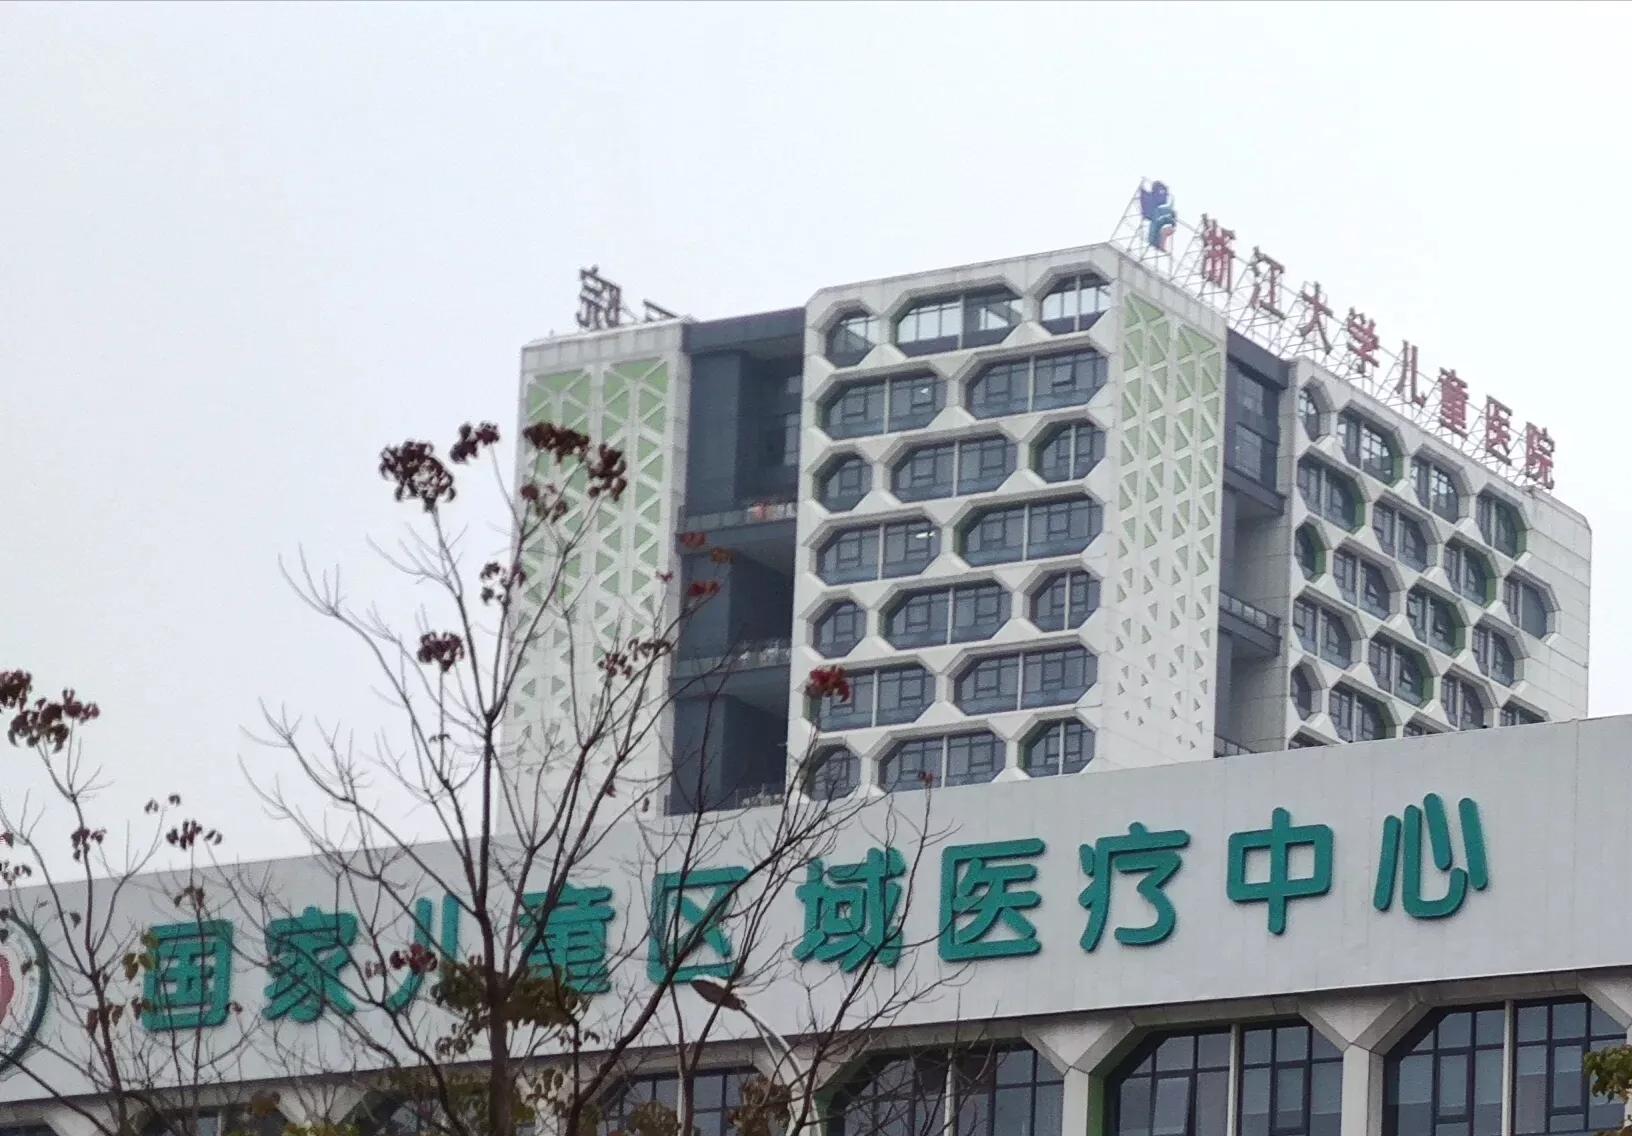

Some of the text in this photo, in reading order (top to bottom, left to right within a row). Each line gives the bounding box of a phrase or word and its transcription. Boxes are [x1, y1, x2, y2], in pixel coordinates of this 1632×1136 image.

[1201, 213, 1555, 489] 浙江大学儿童医院
[142, 792, 1489, 1031] 国家儿童区域医疗中心
